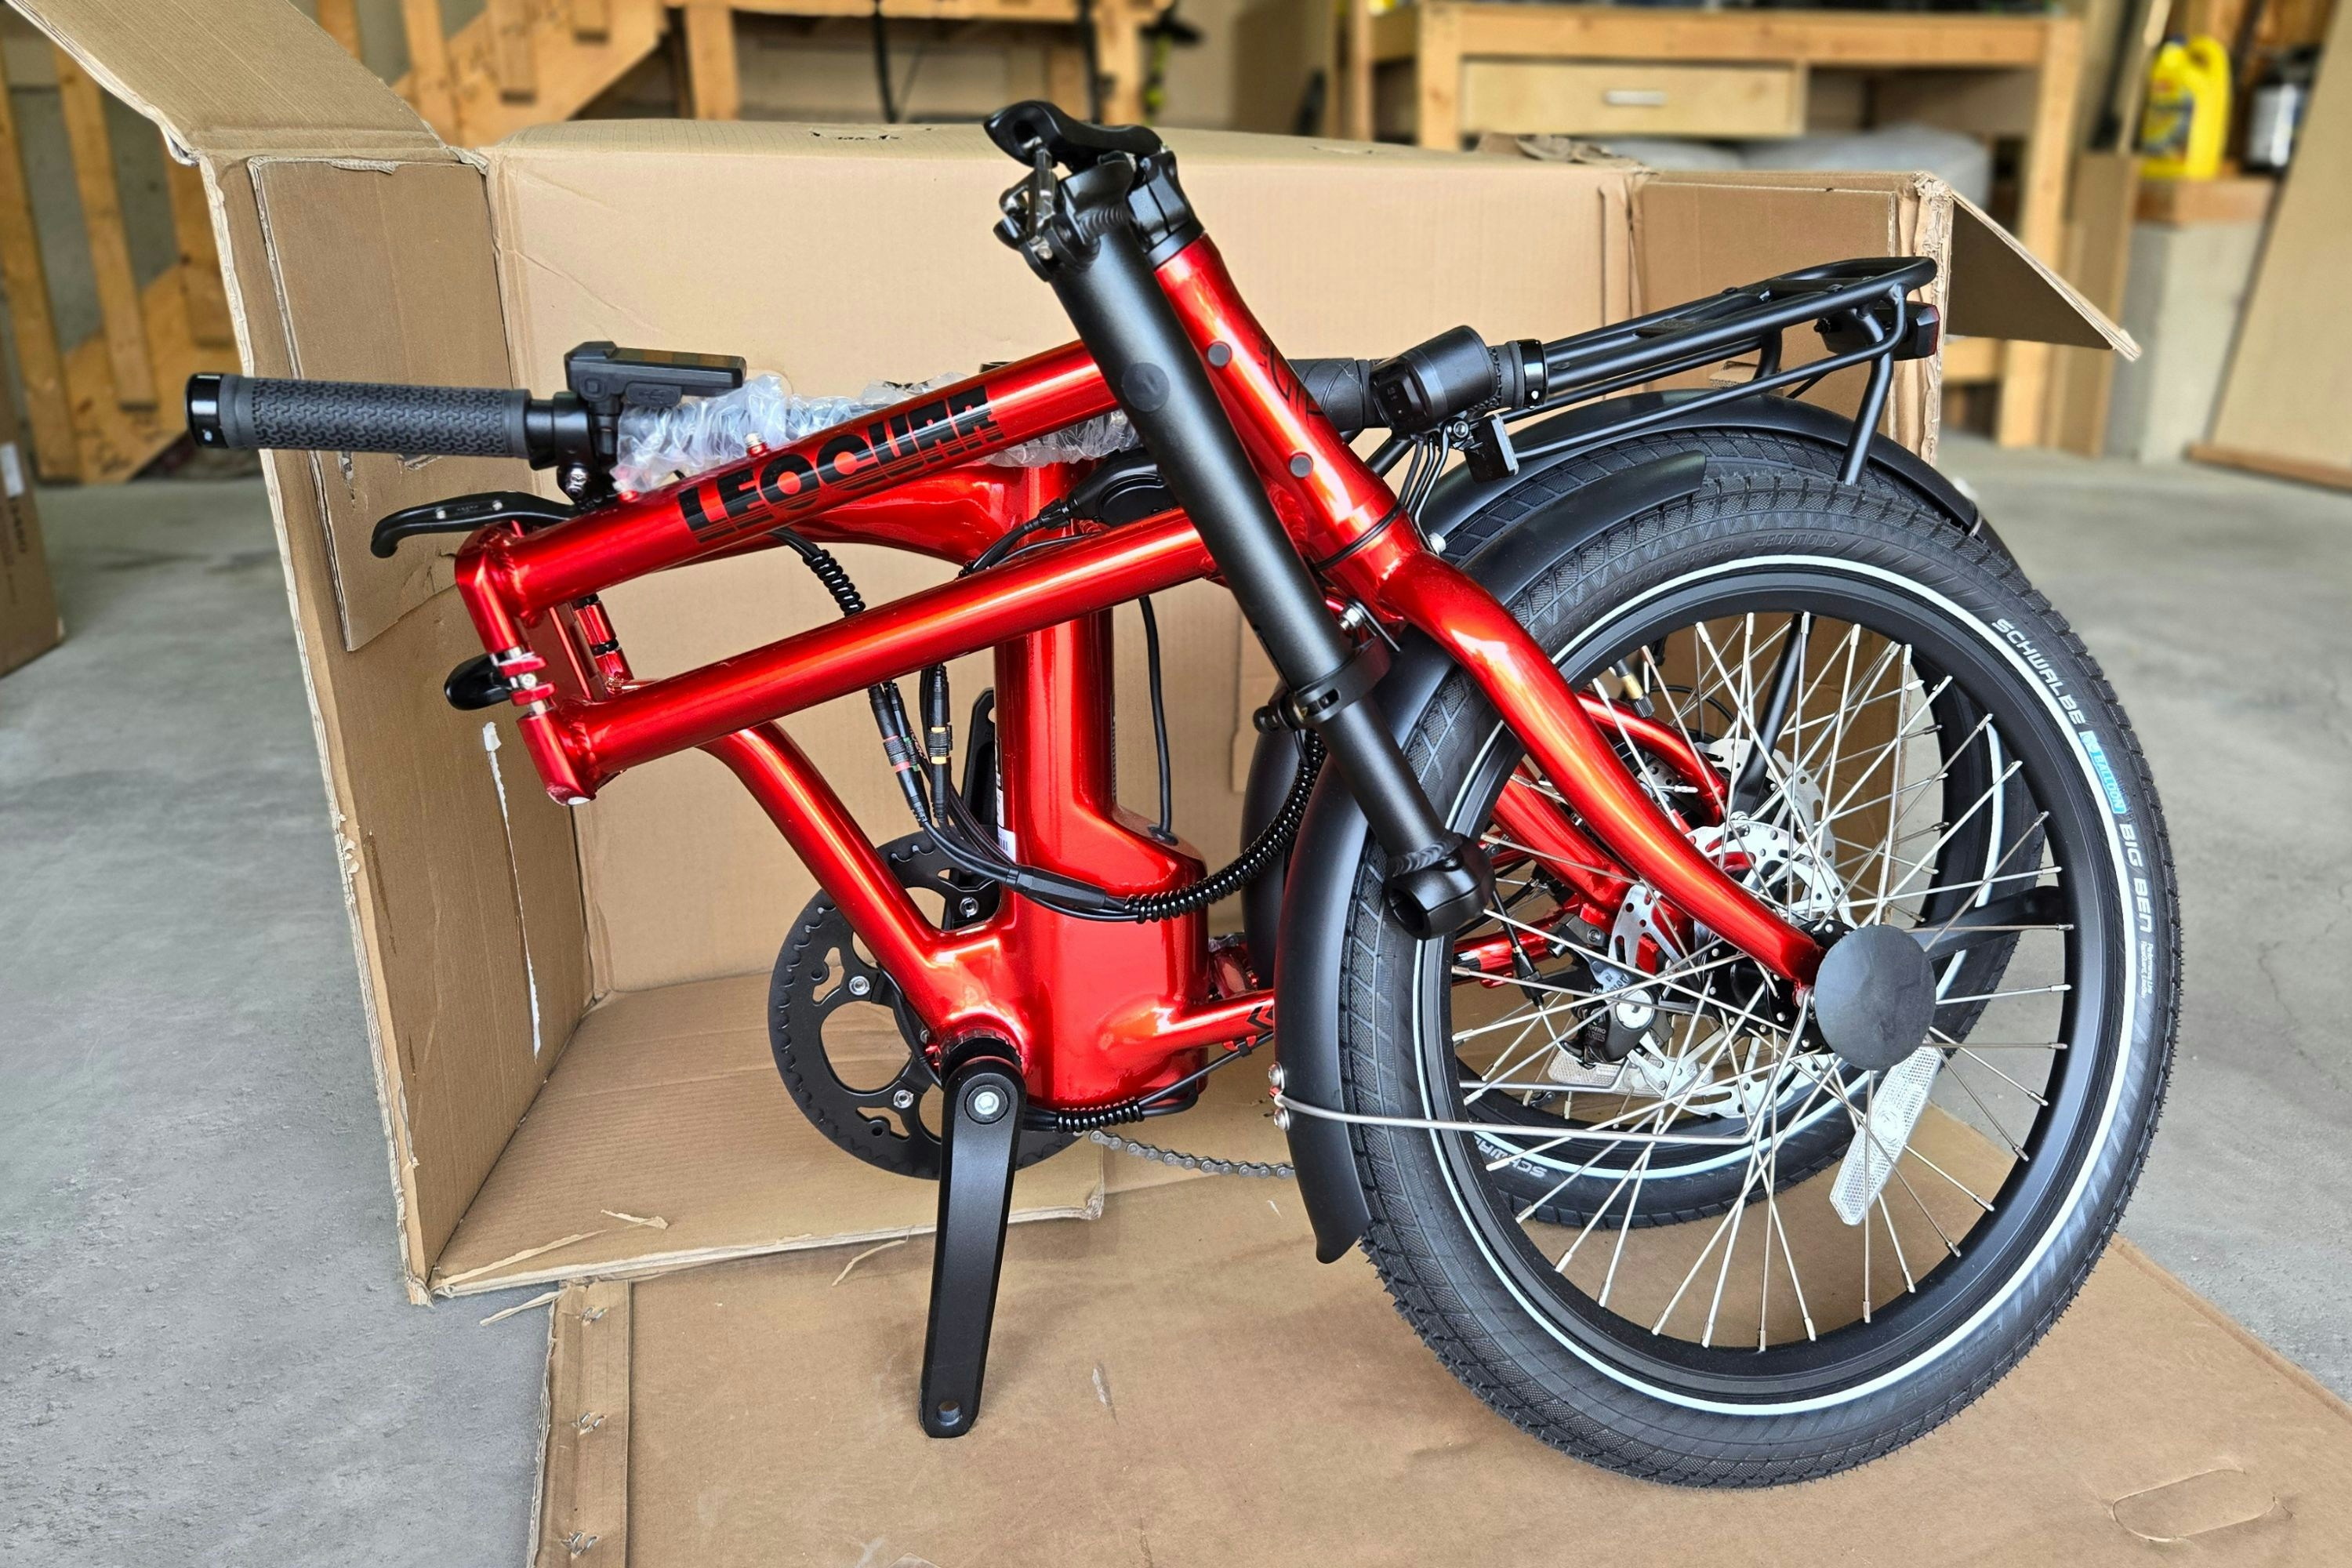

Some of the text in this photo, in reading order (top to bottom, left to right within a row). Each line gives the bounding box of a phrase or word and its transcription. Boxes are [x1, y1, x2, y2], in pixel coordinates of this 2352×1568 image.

[1991, 618, 2086, 725] SCHWALBE
[2094, 754, 2123, 812] BALLOON
[2119, 822, 2152, 934] BIG BEN
[1585, 1030, 1606, 1043] ARIES
